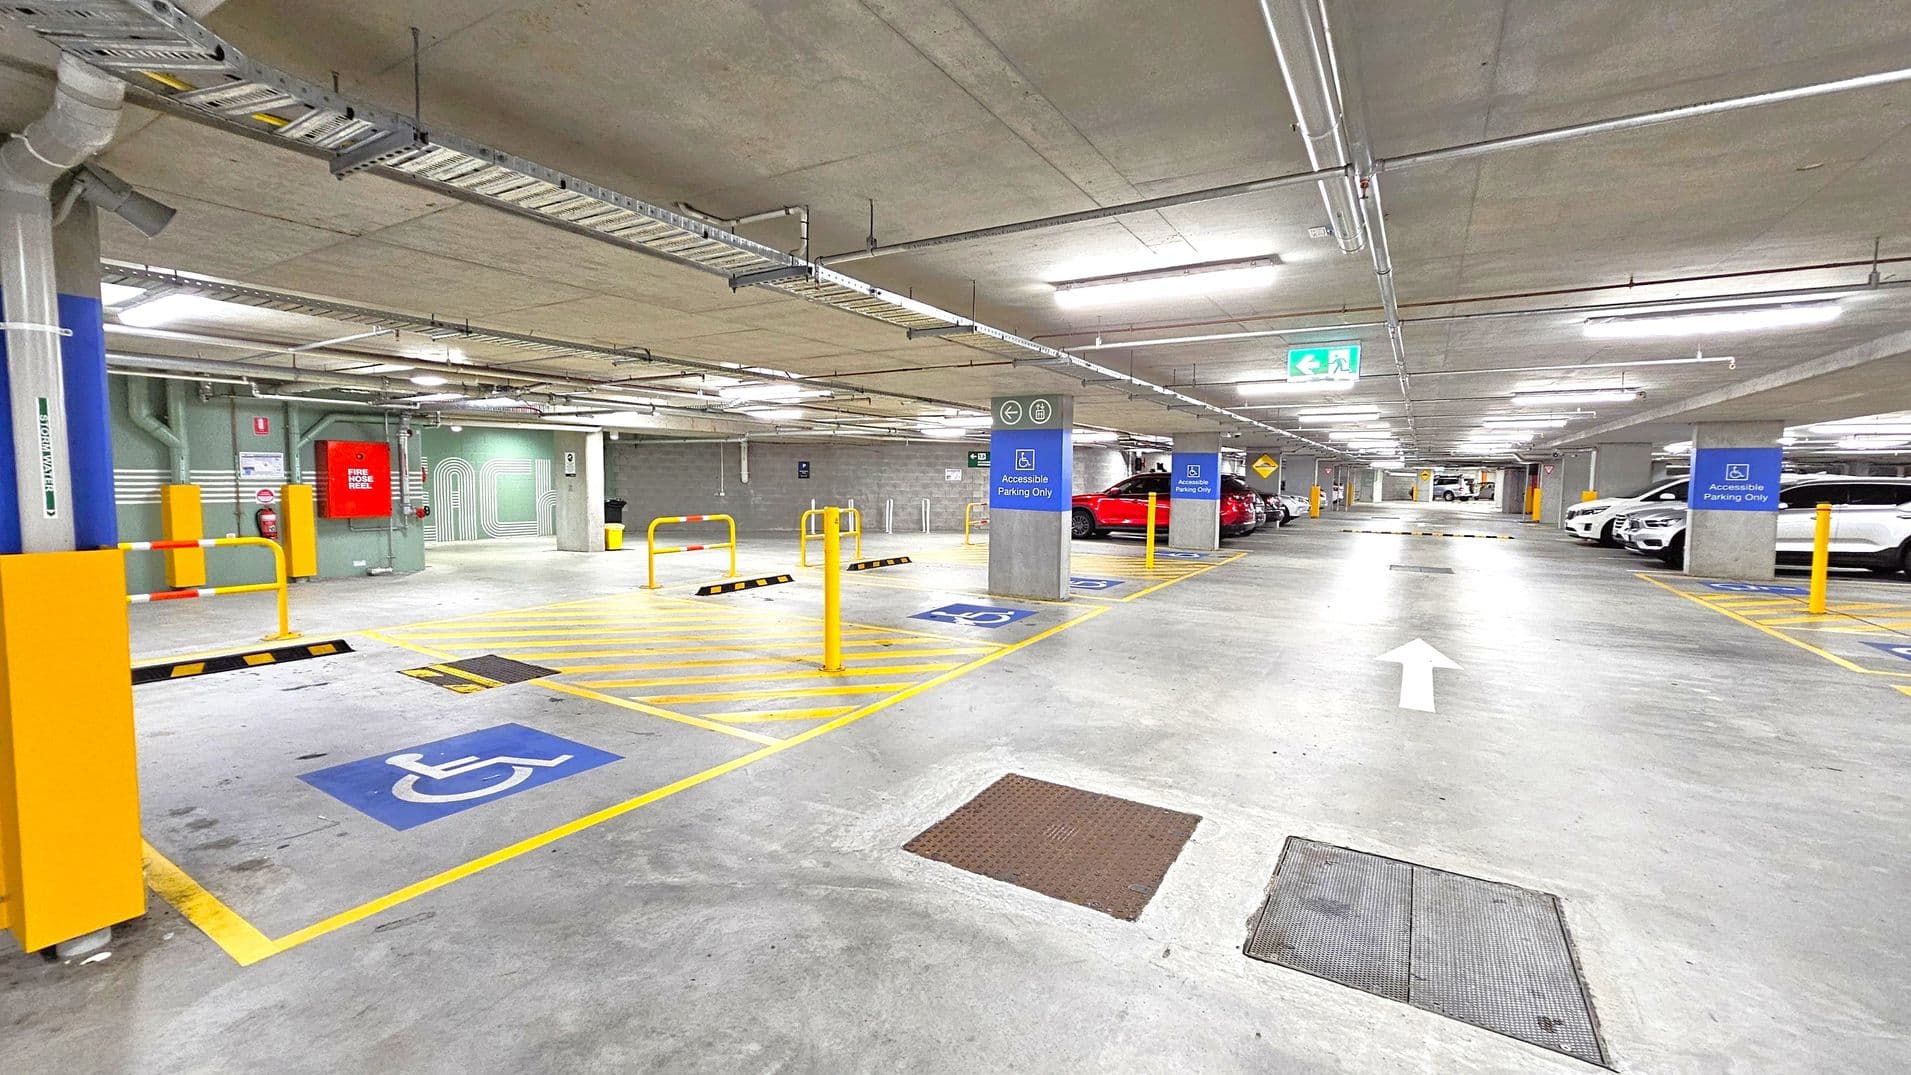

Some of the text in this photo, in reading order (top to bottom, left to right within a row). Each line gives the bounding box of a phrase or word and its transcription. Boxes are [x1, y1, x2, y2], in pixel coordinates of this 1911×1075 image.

[1002, 475, 1048, 483] Accessible
[998, 487, 1052, 498] Parking Only
[1703, 493, 1768, 502] Parking Only
